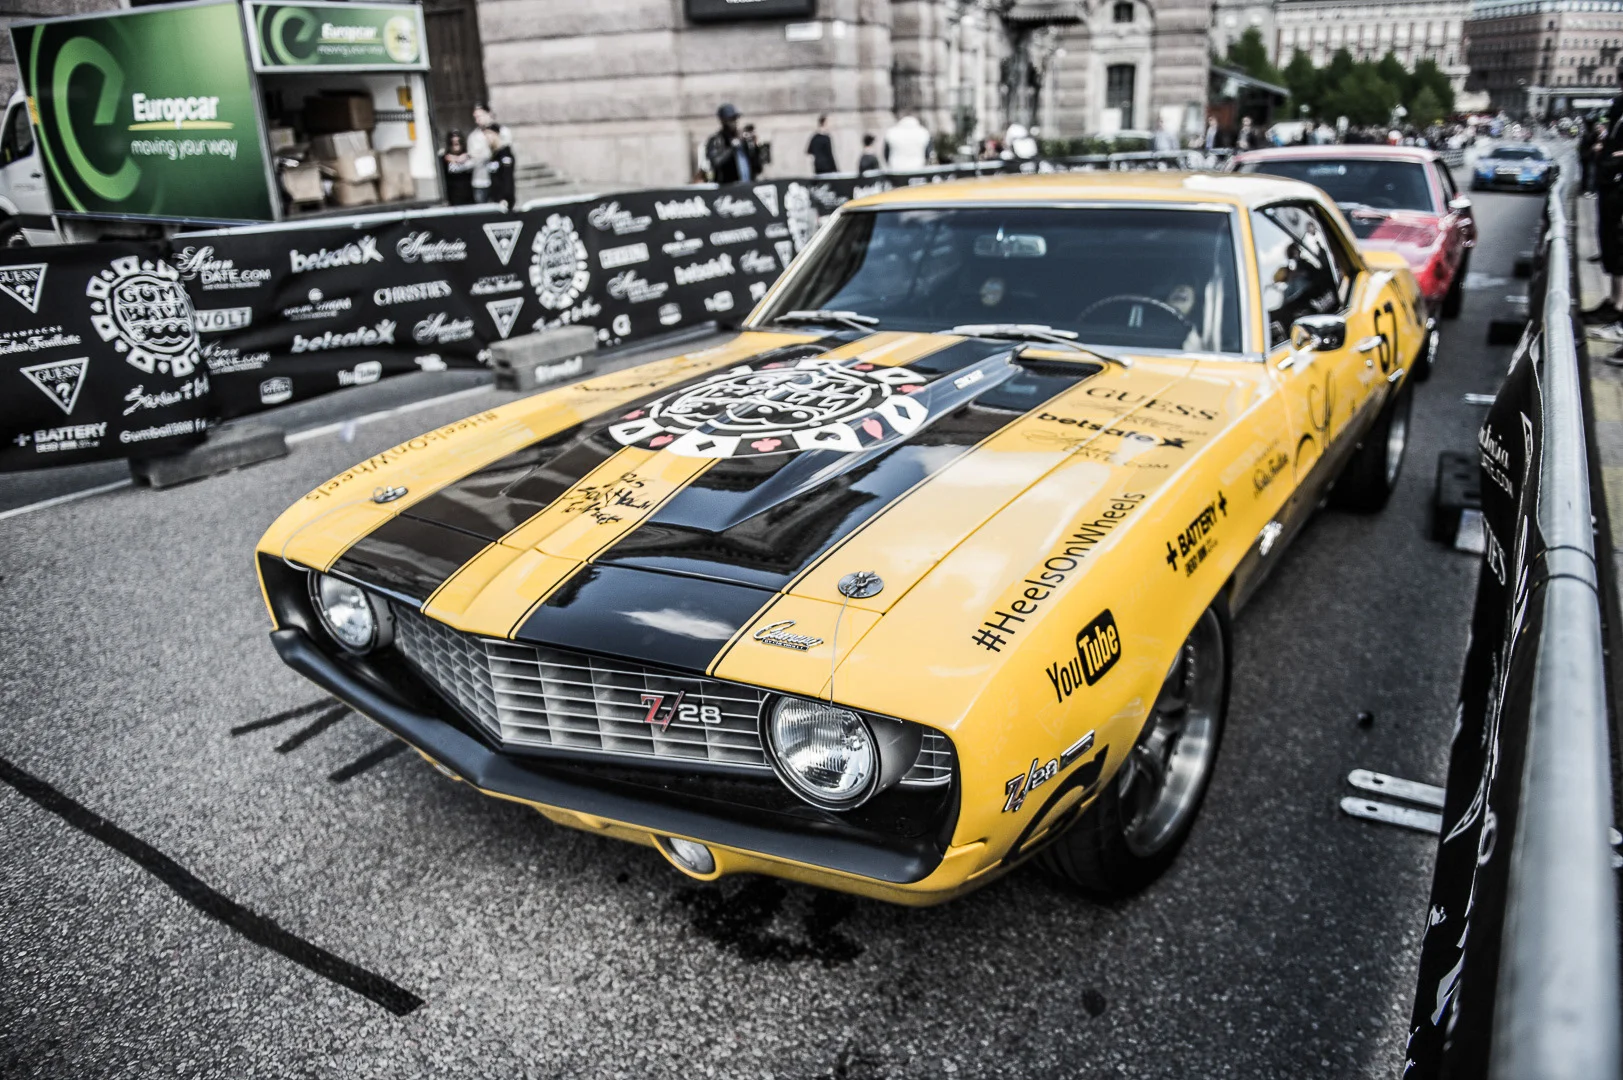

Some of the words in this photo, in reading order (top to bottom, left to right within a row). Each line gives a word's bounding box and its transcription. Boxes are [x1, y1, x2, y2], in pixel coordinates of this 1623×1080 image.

[322, 23, 377, 43] Europcar
[132, 93, 219, 130] Europcar
[131, 137, 178, 160] moving
[178, 139, 207, 160] your
[207, 139, 238, 160] way
[201, 268, 271, 285] DATE.COM
[0, 325, 62, 339] HAMPAGNE
[199, 311, 247, 327] VOLT
[291, 326, 377, 353] betsafe
[34, 365, 81, 382] GUESS
[1086, 387, 1219, 420] GUESS
[34, 422, 107, 443] BATTERY
[1037, 412, 1154, 443] betsafe
[306, 411, 499, 501] #HeelsOnWheels
[1177, 501, 1218, 557] BATTERY
[972, 492, 1146, 652] #HeelsOnWheels
[753, 619, 824, 647] Camaro
[1046, 608, 1121, 703] YouTube
[640, 690, 722, 732] Z/28
[1001, 758, 1059, 813] Z/28
